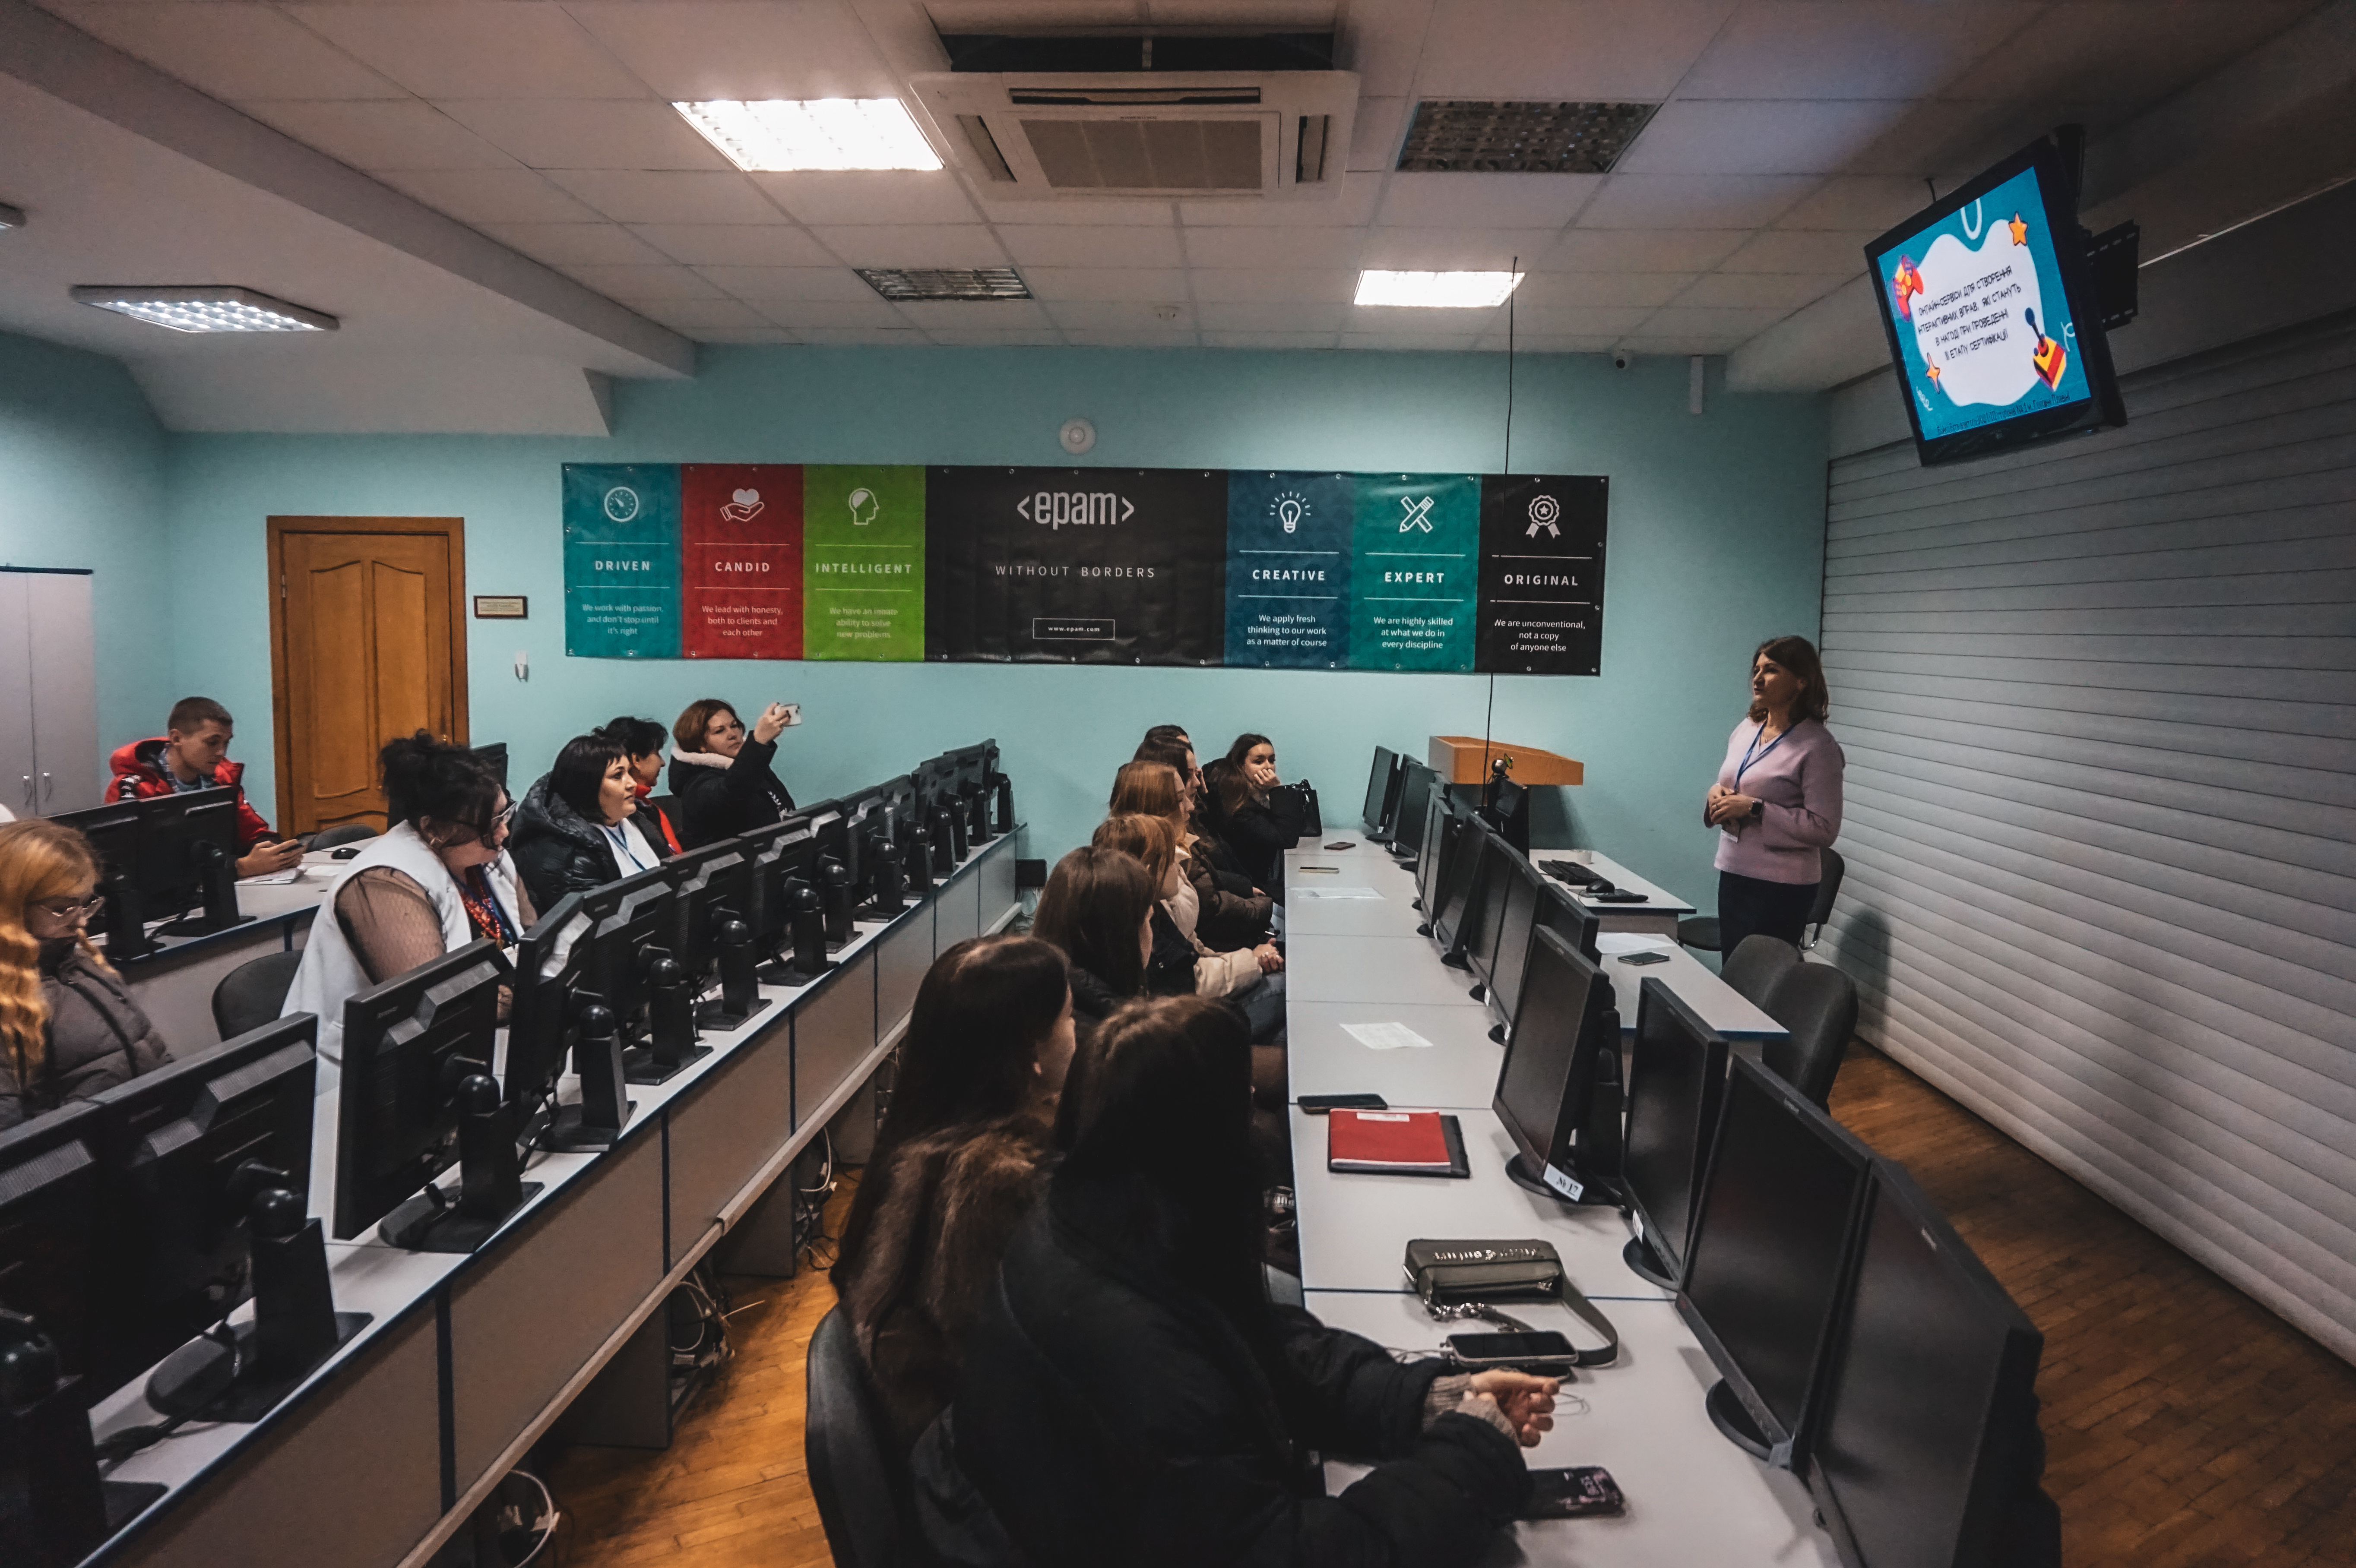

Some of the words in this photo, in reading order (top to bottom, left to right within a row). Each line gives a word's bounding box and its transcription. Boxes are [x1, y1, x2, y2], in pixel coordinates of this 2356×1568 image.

[1963, 282, 1976, 297] ДЛЯ
[1976, 265, 2012, 289] СТВОРЕННЯ
[1982, 295, 1991, 307] ЯКІ
[1992, 283, 2021, 302] СТАНУТЬ
[1935, 337, 1940, 346] В
[1941, 328, 1960, 343] НАГОДІ
[1960, 325, 1971, 335] ПРИ
[1950, 345, 1968, 359] ЕТАПУ
[595, 561, 650, 571] DRIVEN
[715, 562, 770, 572] CANDID
[816, 563, 912, 574] INTELLIGENT
[995, 565, 1069, 576] WITHOUT
[1081, 567, 1155, 578] BORDERS
[1252, 569, 1326, 581] CREATIVE
[1385, 572, 1445, 584] EXPERT
[1504, 574, 1578, 586] ORIGINAL
[751, 606, 783, 615] honesty,
[836, 619, 860, 627] ability
[1273, 614, 1294, 624] apply
[1402, 616, 1425, 627] highly
[1428, 617, 1453, 626] skilled
[1522, 620, 1585, 629] unconventional,
[620, 628, 637, 636] right
[855, 631, 890, 639] problems
[1248, 626, 1280, 635] thinking
[1391, 628, 1410, 636] what
[1540, 633, 1559, 641] copy
[1382, 641, 1403, 650] every
[1405, 640, 1443, 650] discipline
[1520, 644, 1549, 652] anyone
[1568, 1183, 1579, 1193] 17
